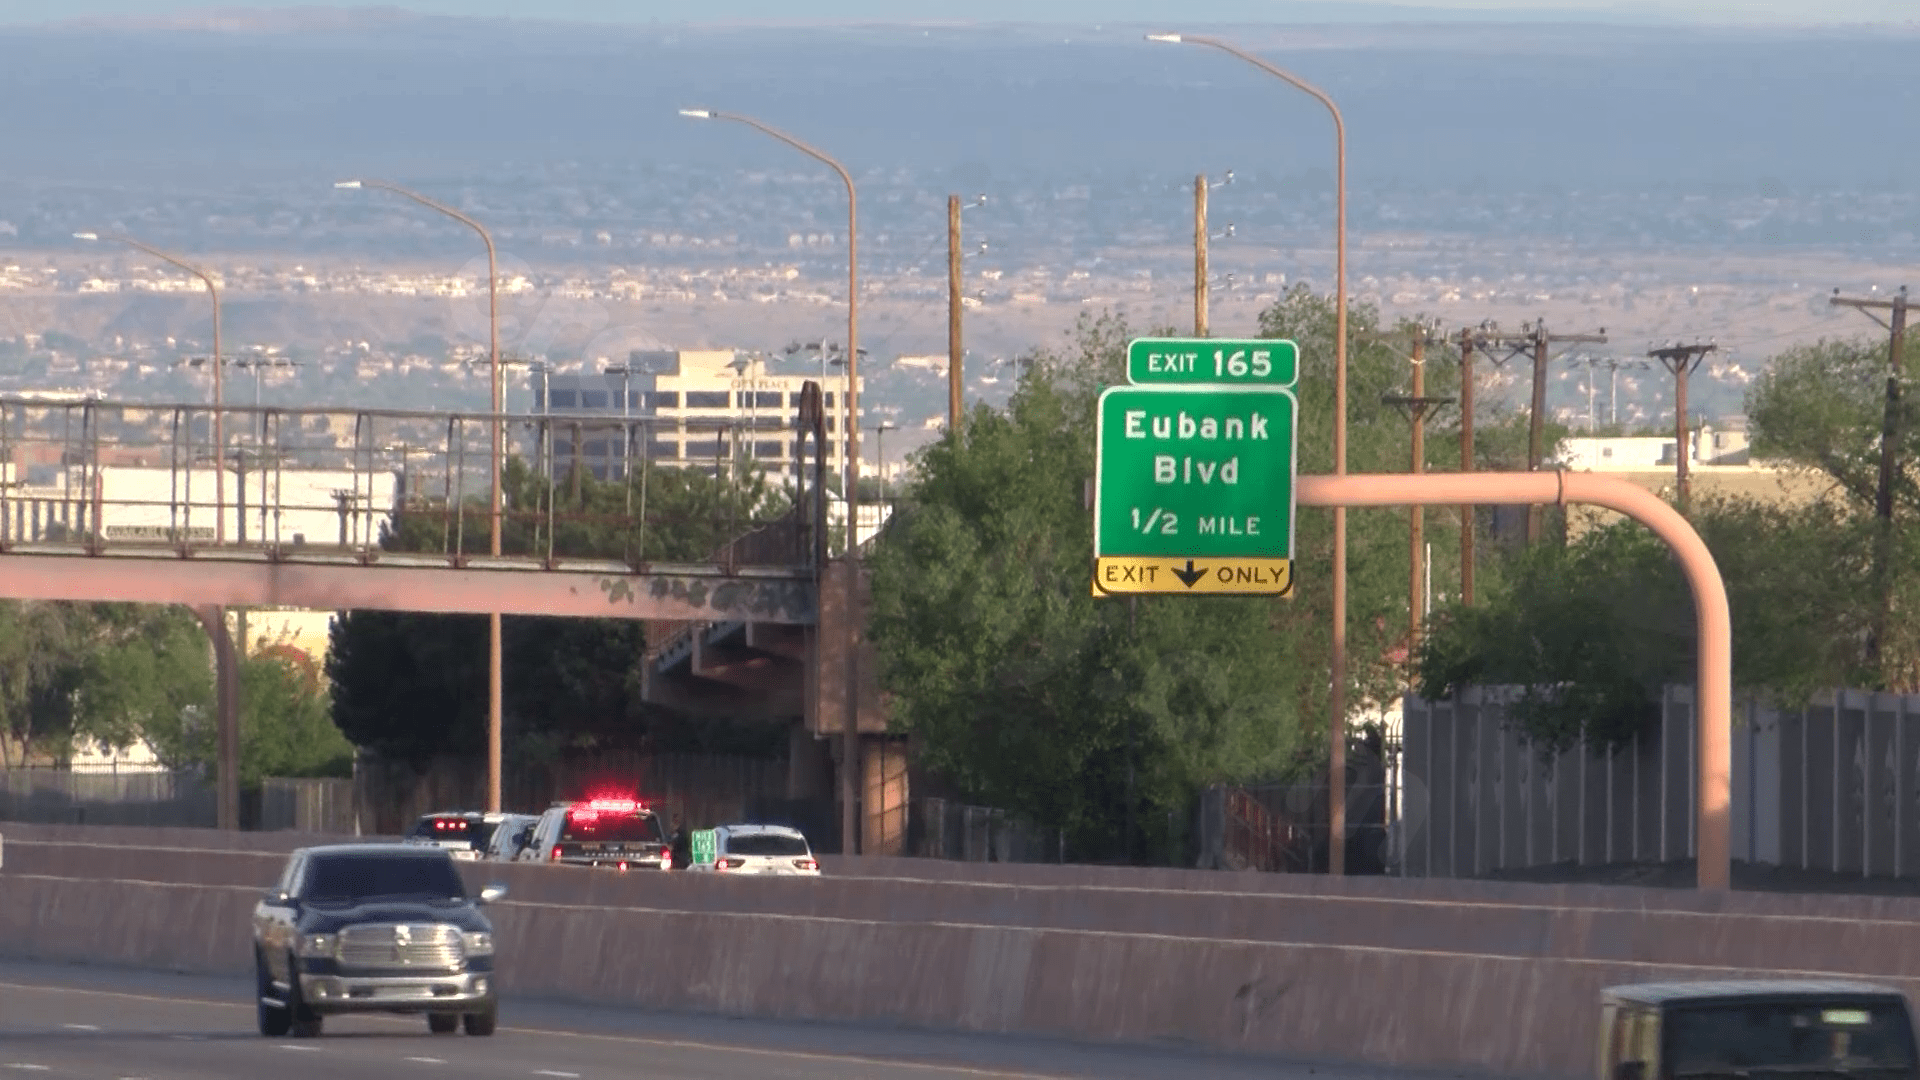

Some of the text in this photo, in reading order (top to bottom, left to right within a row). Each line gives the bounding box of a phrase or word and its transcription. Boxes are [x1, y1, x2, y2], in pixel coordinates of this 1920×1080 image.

[1148, 350, 1272, 377] EXIT 165
[1125, 410, 1269, 440] Eubank
[1154, 455, 1239, 484] Blvd
[1131, 507, 1261, 535] 1/2 MILE
[1105, 565, 1285, 584] EXIT ONLY
